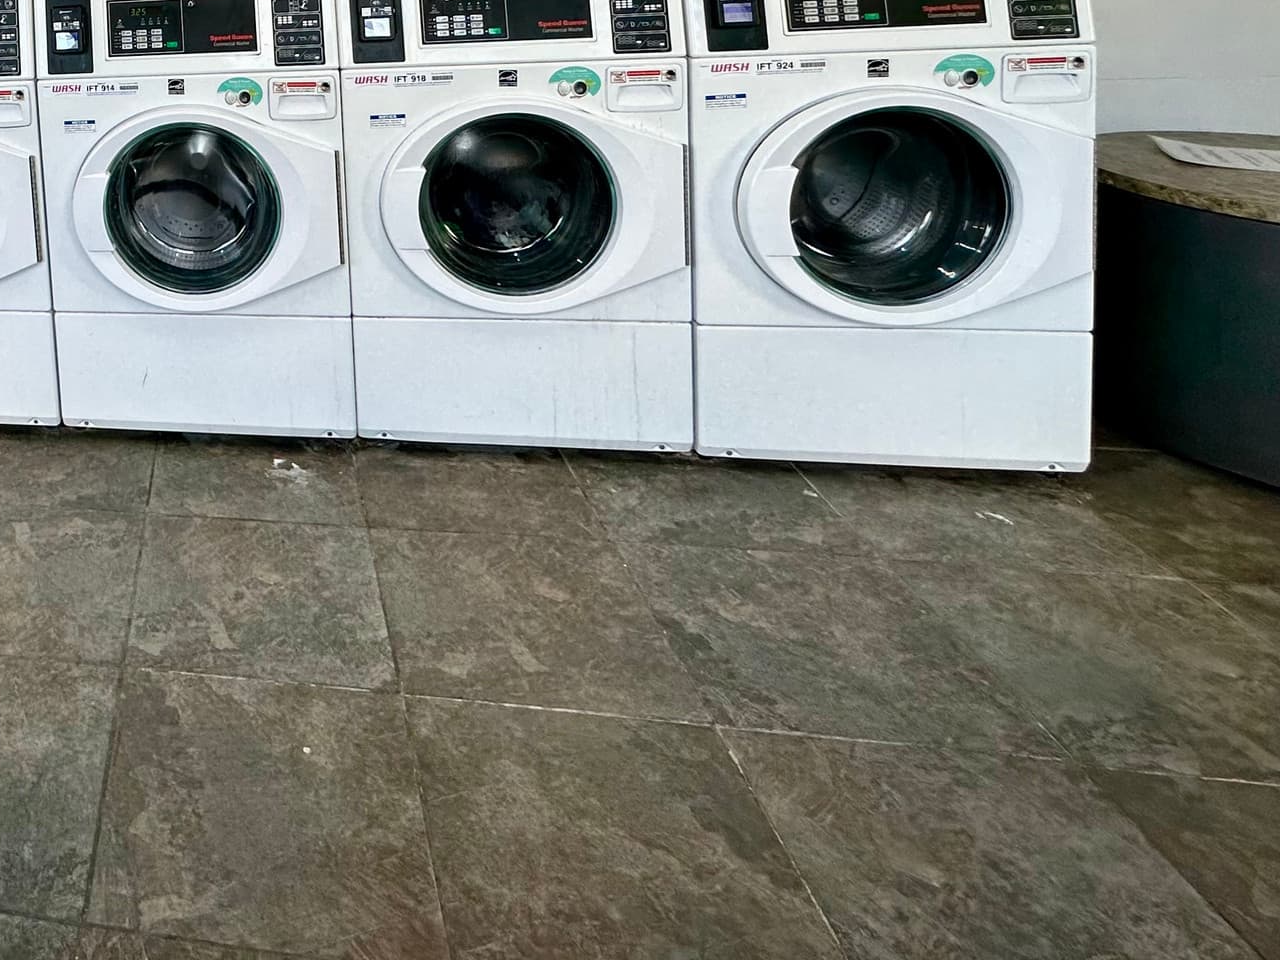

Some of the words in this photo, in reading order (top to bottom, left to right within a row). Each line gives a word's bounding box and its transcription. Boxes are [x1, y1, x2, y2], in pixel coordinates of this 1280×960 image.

[710, 63, 750, 73] WASH
[756, 63, 772, 71] IFT
[776, 62, 794, 70] 924
[355, 75, 388, 85] WASH
[394, 75, 407, 83] IFT
[52, 85, 81, 93] WASH
[101, 84, 115, 92] 914
